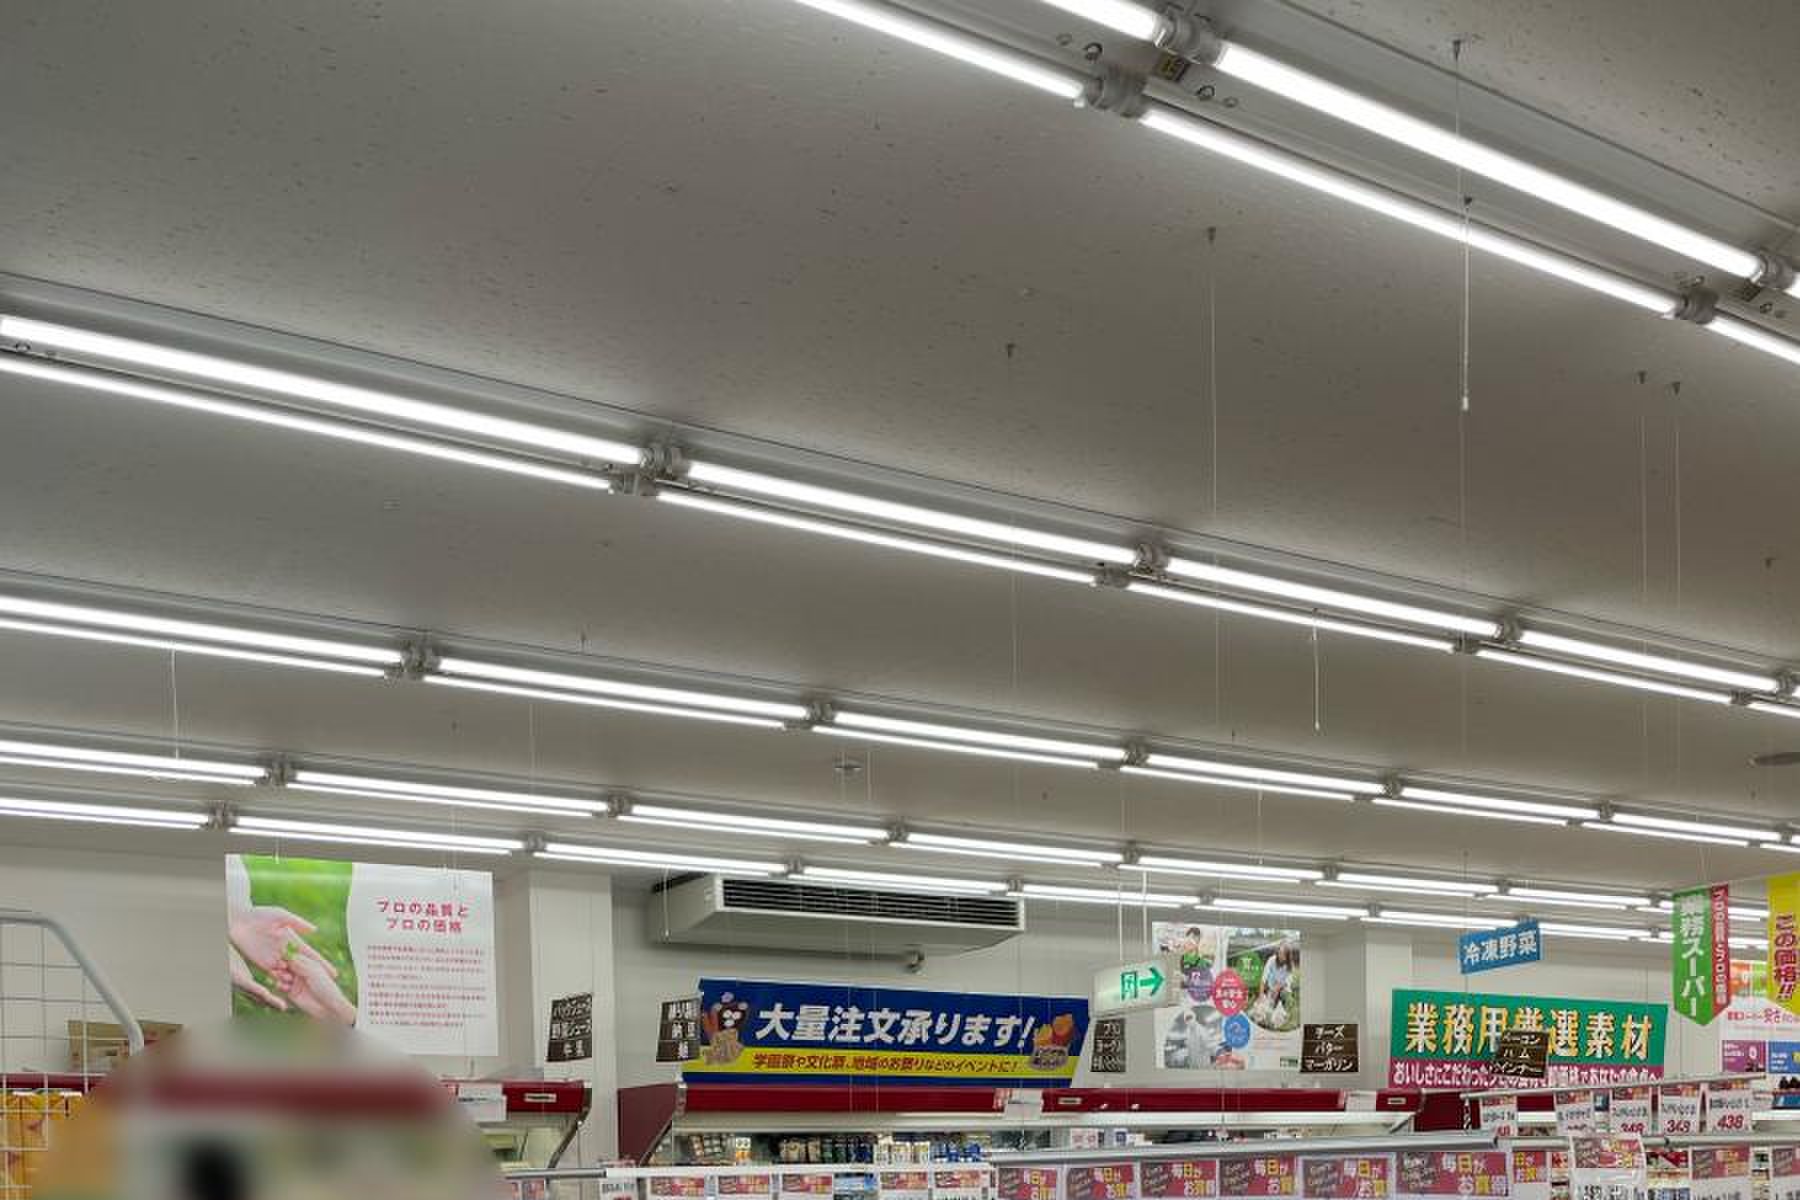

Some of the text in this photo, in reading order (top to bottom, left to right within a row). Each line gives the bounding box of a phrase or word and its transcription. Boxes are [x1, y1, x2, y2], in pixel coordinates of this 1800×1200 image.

[376, 900, 469, 918] プロの品質と
[385, 918, 463, 934] プロの価格
[1461, 930, 1539, 964] 冷凍野菜
[1679, 893, 1705, 1017] 業務スーパー
[1314, 1041, 1345, 1055] バター
[1503, 1049, 1530, 1060] ハム
[1304, 1057, 1353, 1072] マーガリン
[1716, 1114, 1745, 1129] 438
